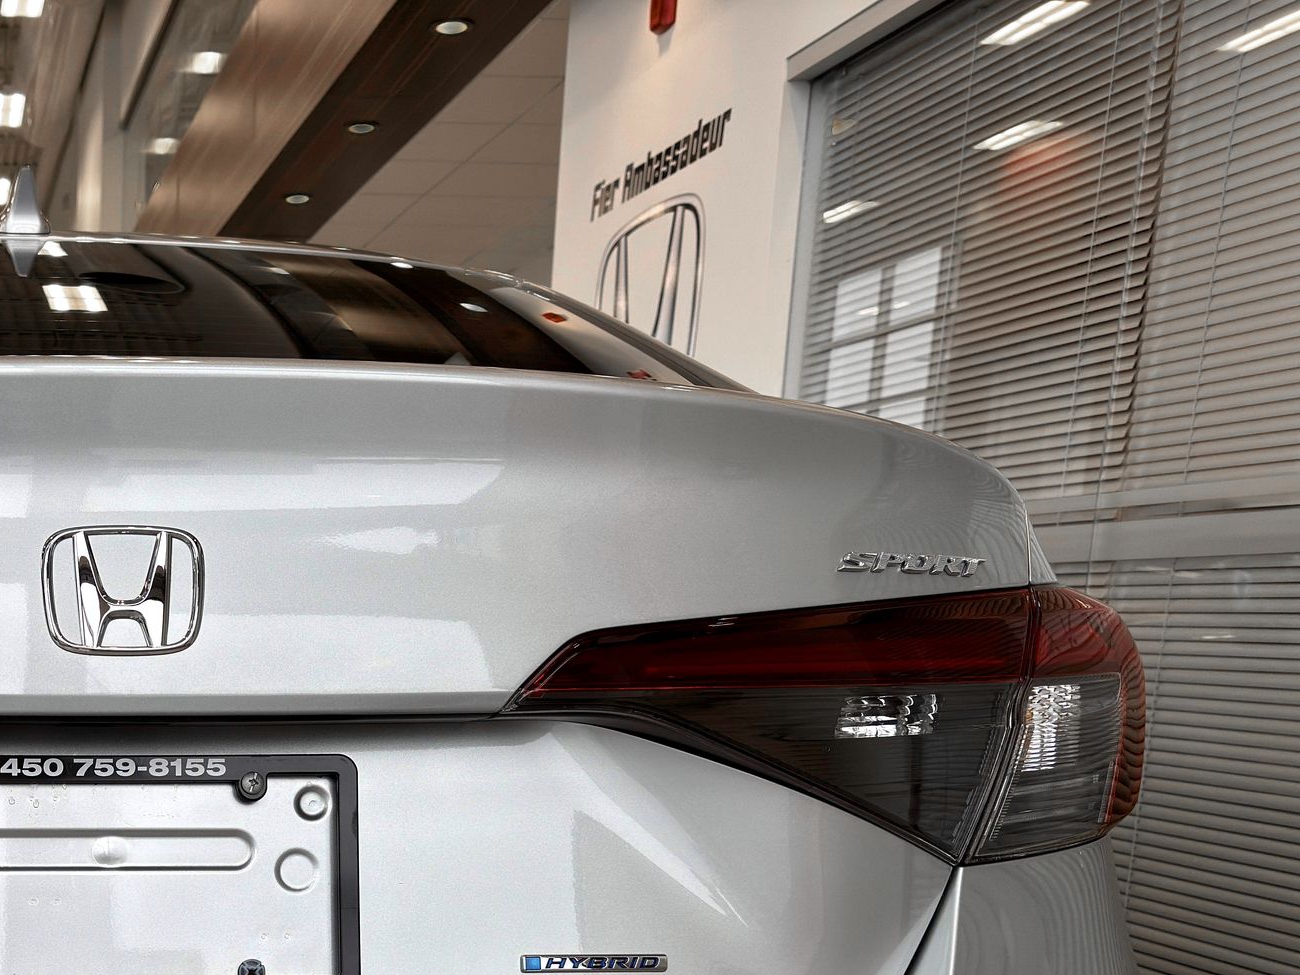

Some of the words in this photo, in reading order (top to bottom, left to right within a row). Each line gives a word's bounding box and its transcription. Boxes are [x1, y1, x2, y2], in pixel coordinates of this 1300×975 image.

[591, 178, 620, 222] Fier
[622, 107, 732, 204] Ambassadeur
[837, 552, 986, 577] SPORT
[0, 758, 64, 777] 450
[74, 757, 227, 777] 759-8155
[545, 956, 660, 969] HYBRID
